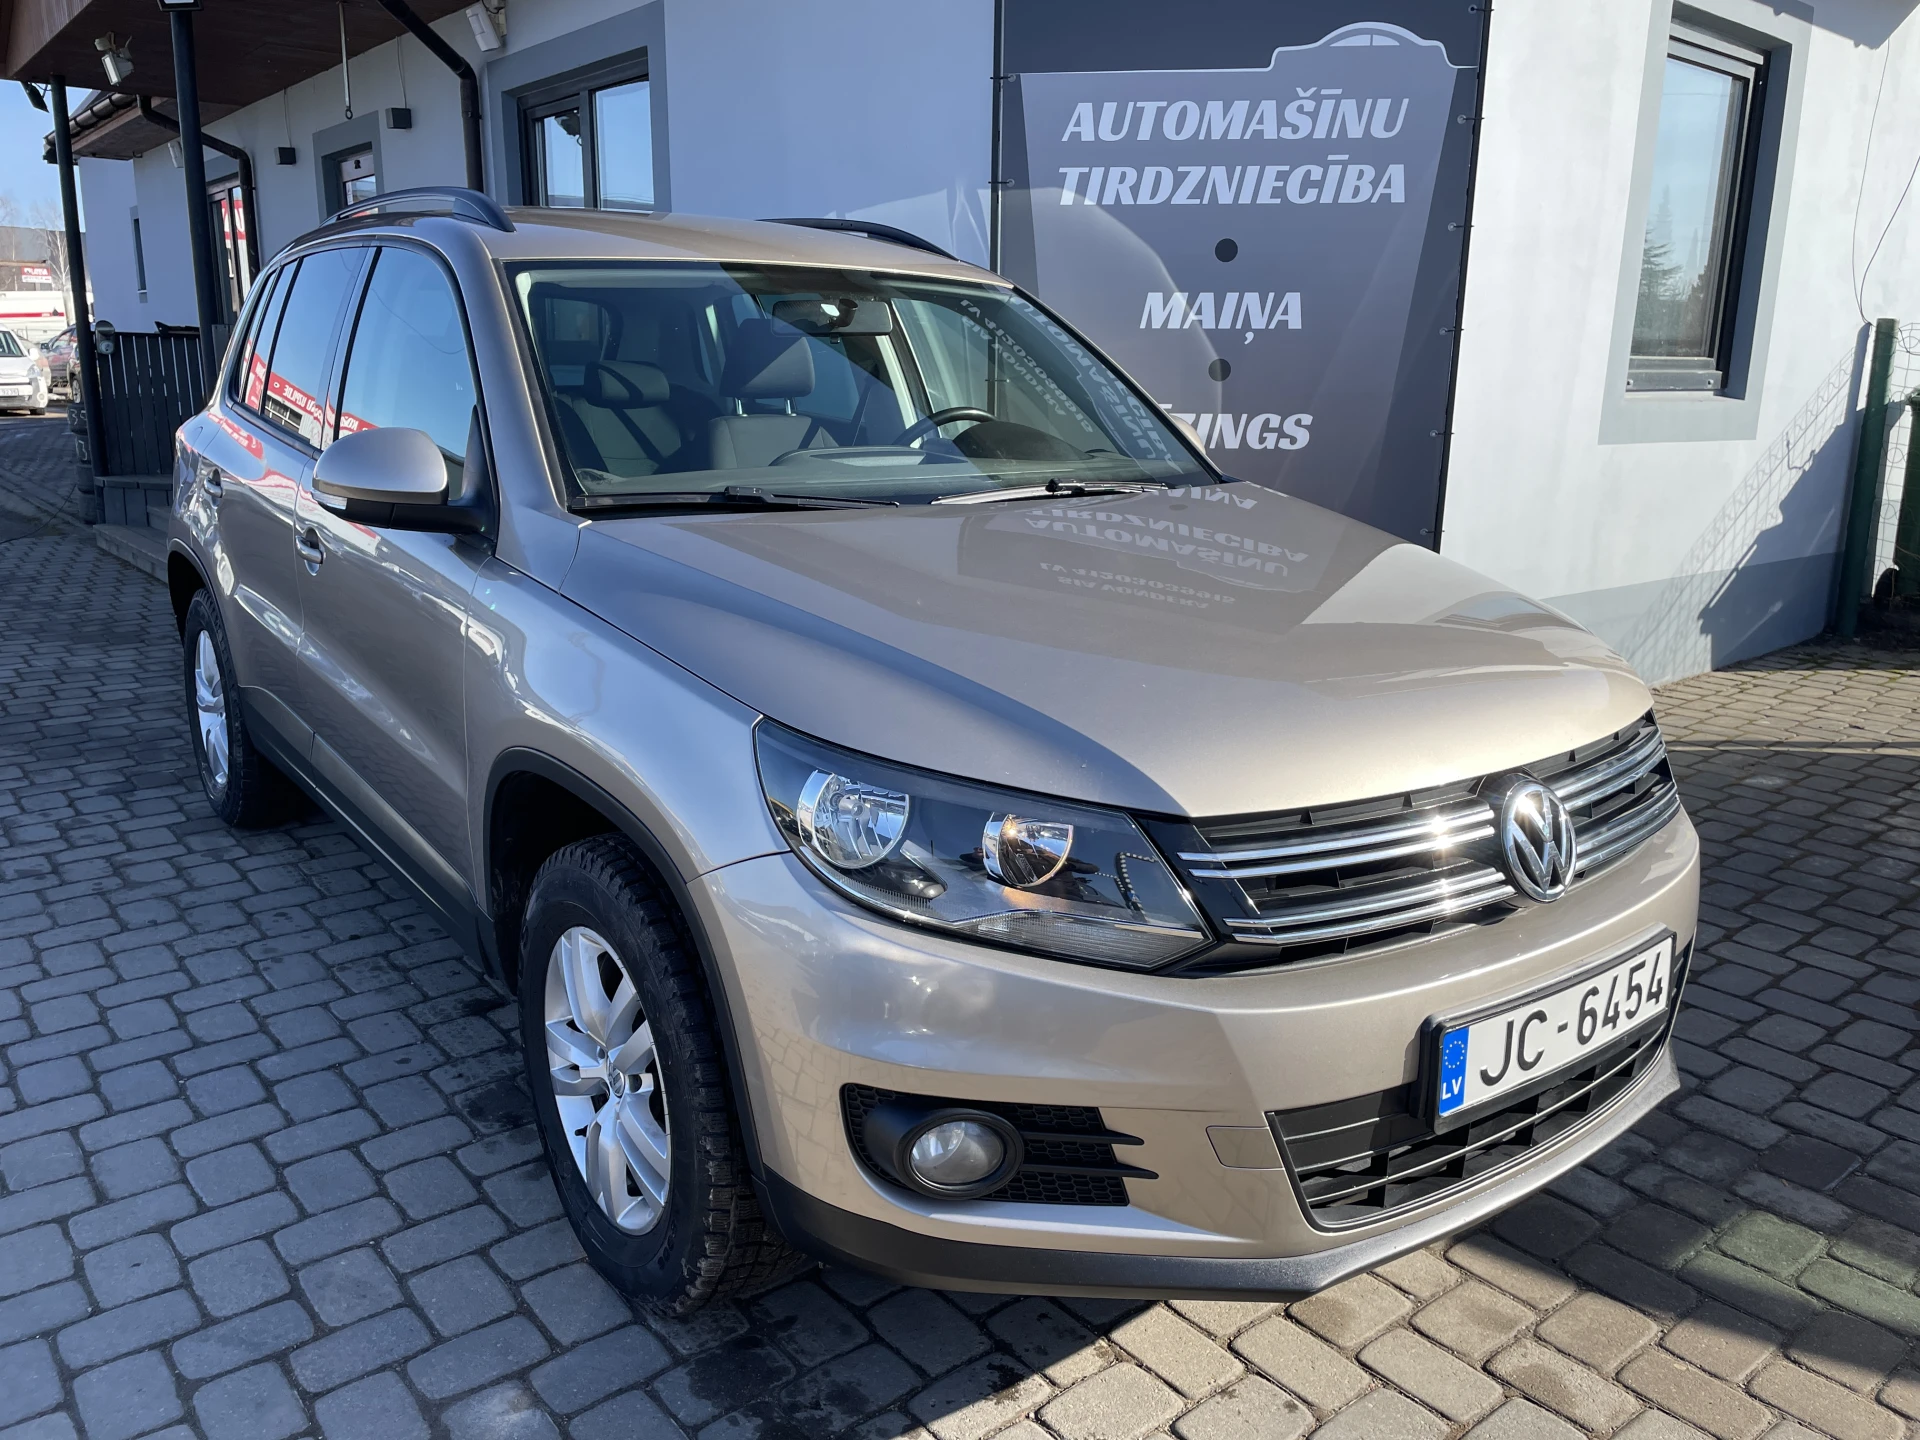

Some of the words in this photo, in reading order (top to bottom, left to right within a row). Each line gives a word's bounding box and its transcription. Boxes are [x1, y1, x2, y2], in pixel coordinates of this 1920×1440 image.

[1061, 87, 1410, 142] AUTOMAŠĪNU
[1058, 154, 1406, 206] TIRDZNIECĪBA
[1139, 291, 1303, 346] MAIŅA
[1441, 1075, 1463, 1100] LV
